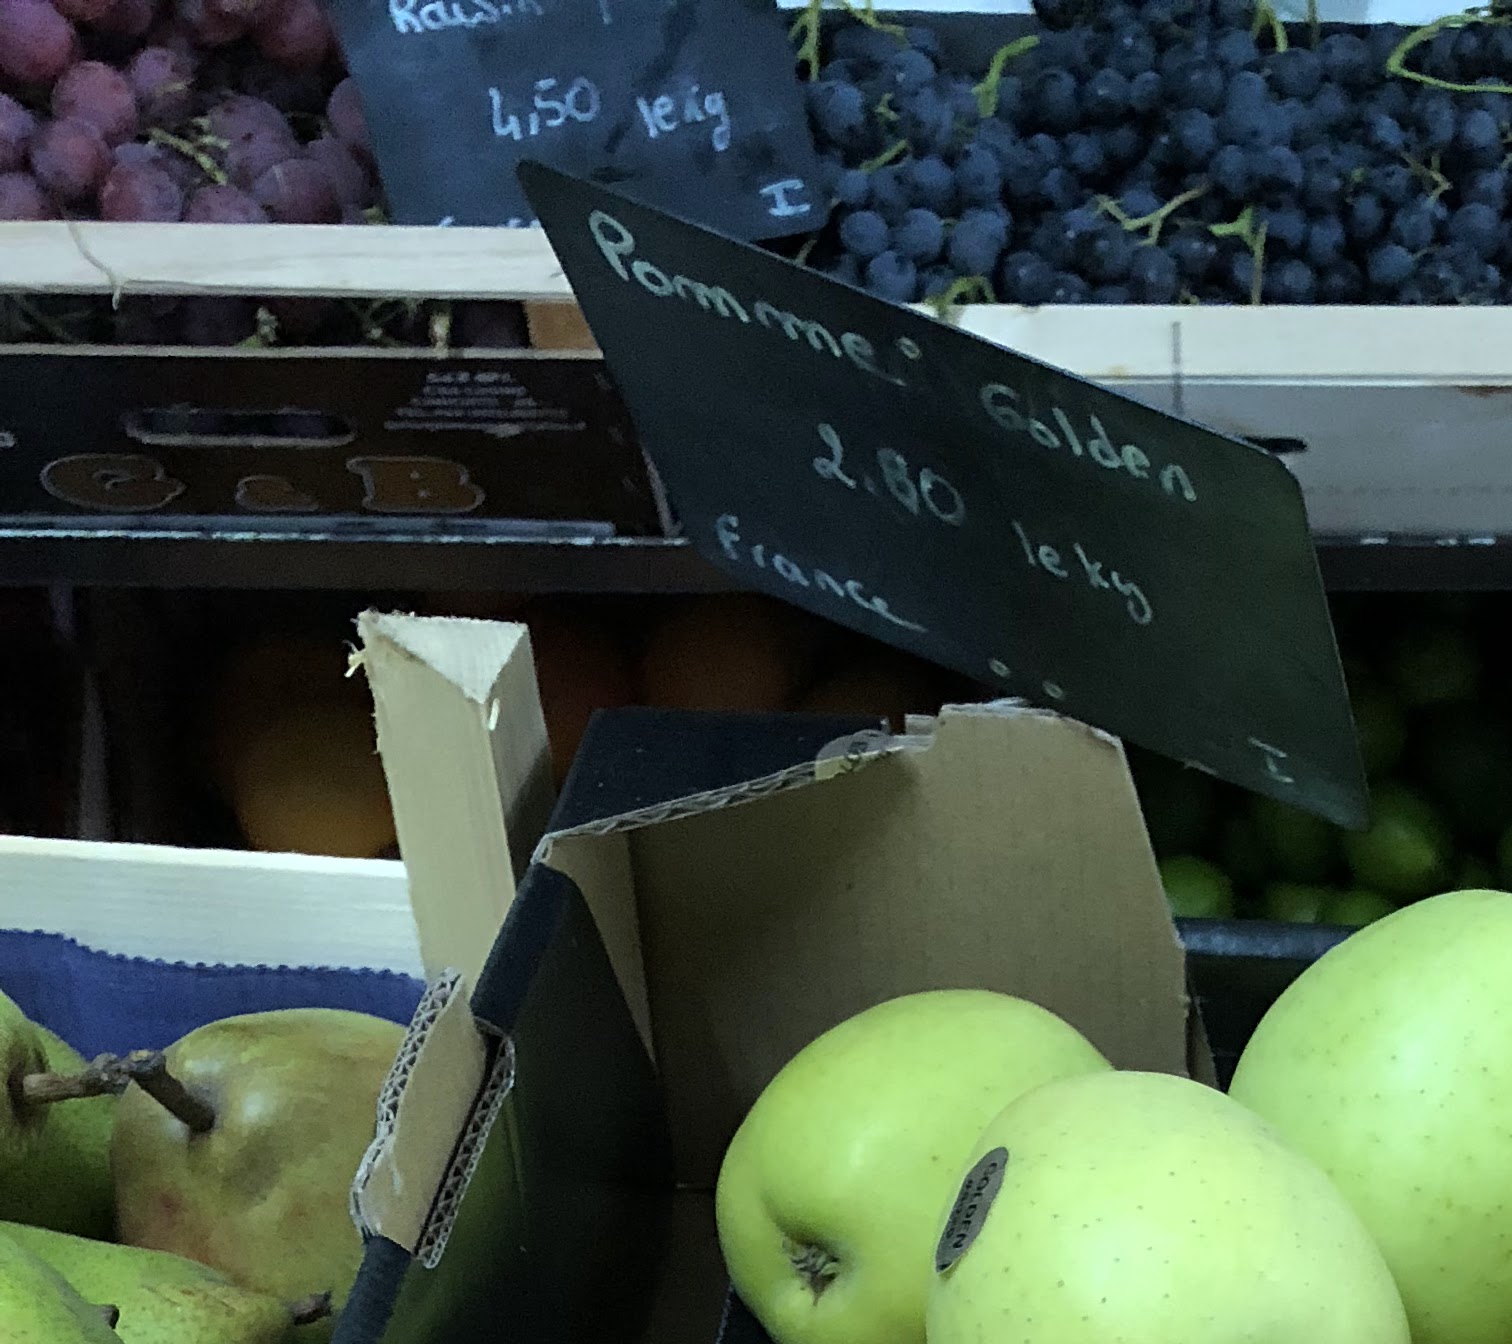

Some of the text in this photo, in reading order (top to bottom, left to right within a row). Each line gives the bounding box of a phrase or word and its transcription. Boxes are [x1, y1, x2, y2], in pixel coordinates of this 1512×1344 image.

[589, 211, 1198, 504] Pomme Golden
[952, 1161, 998, 1250] GOLDEN
